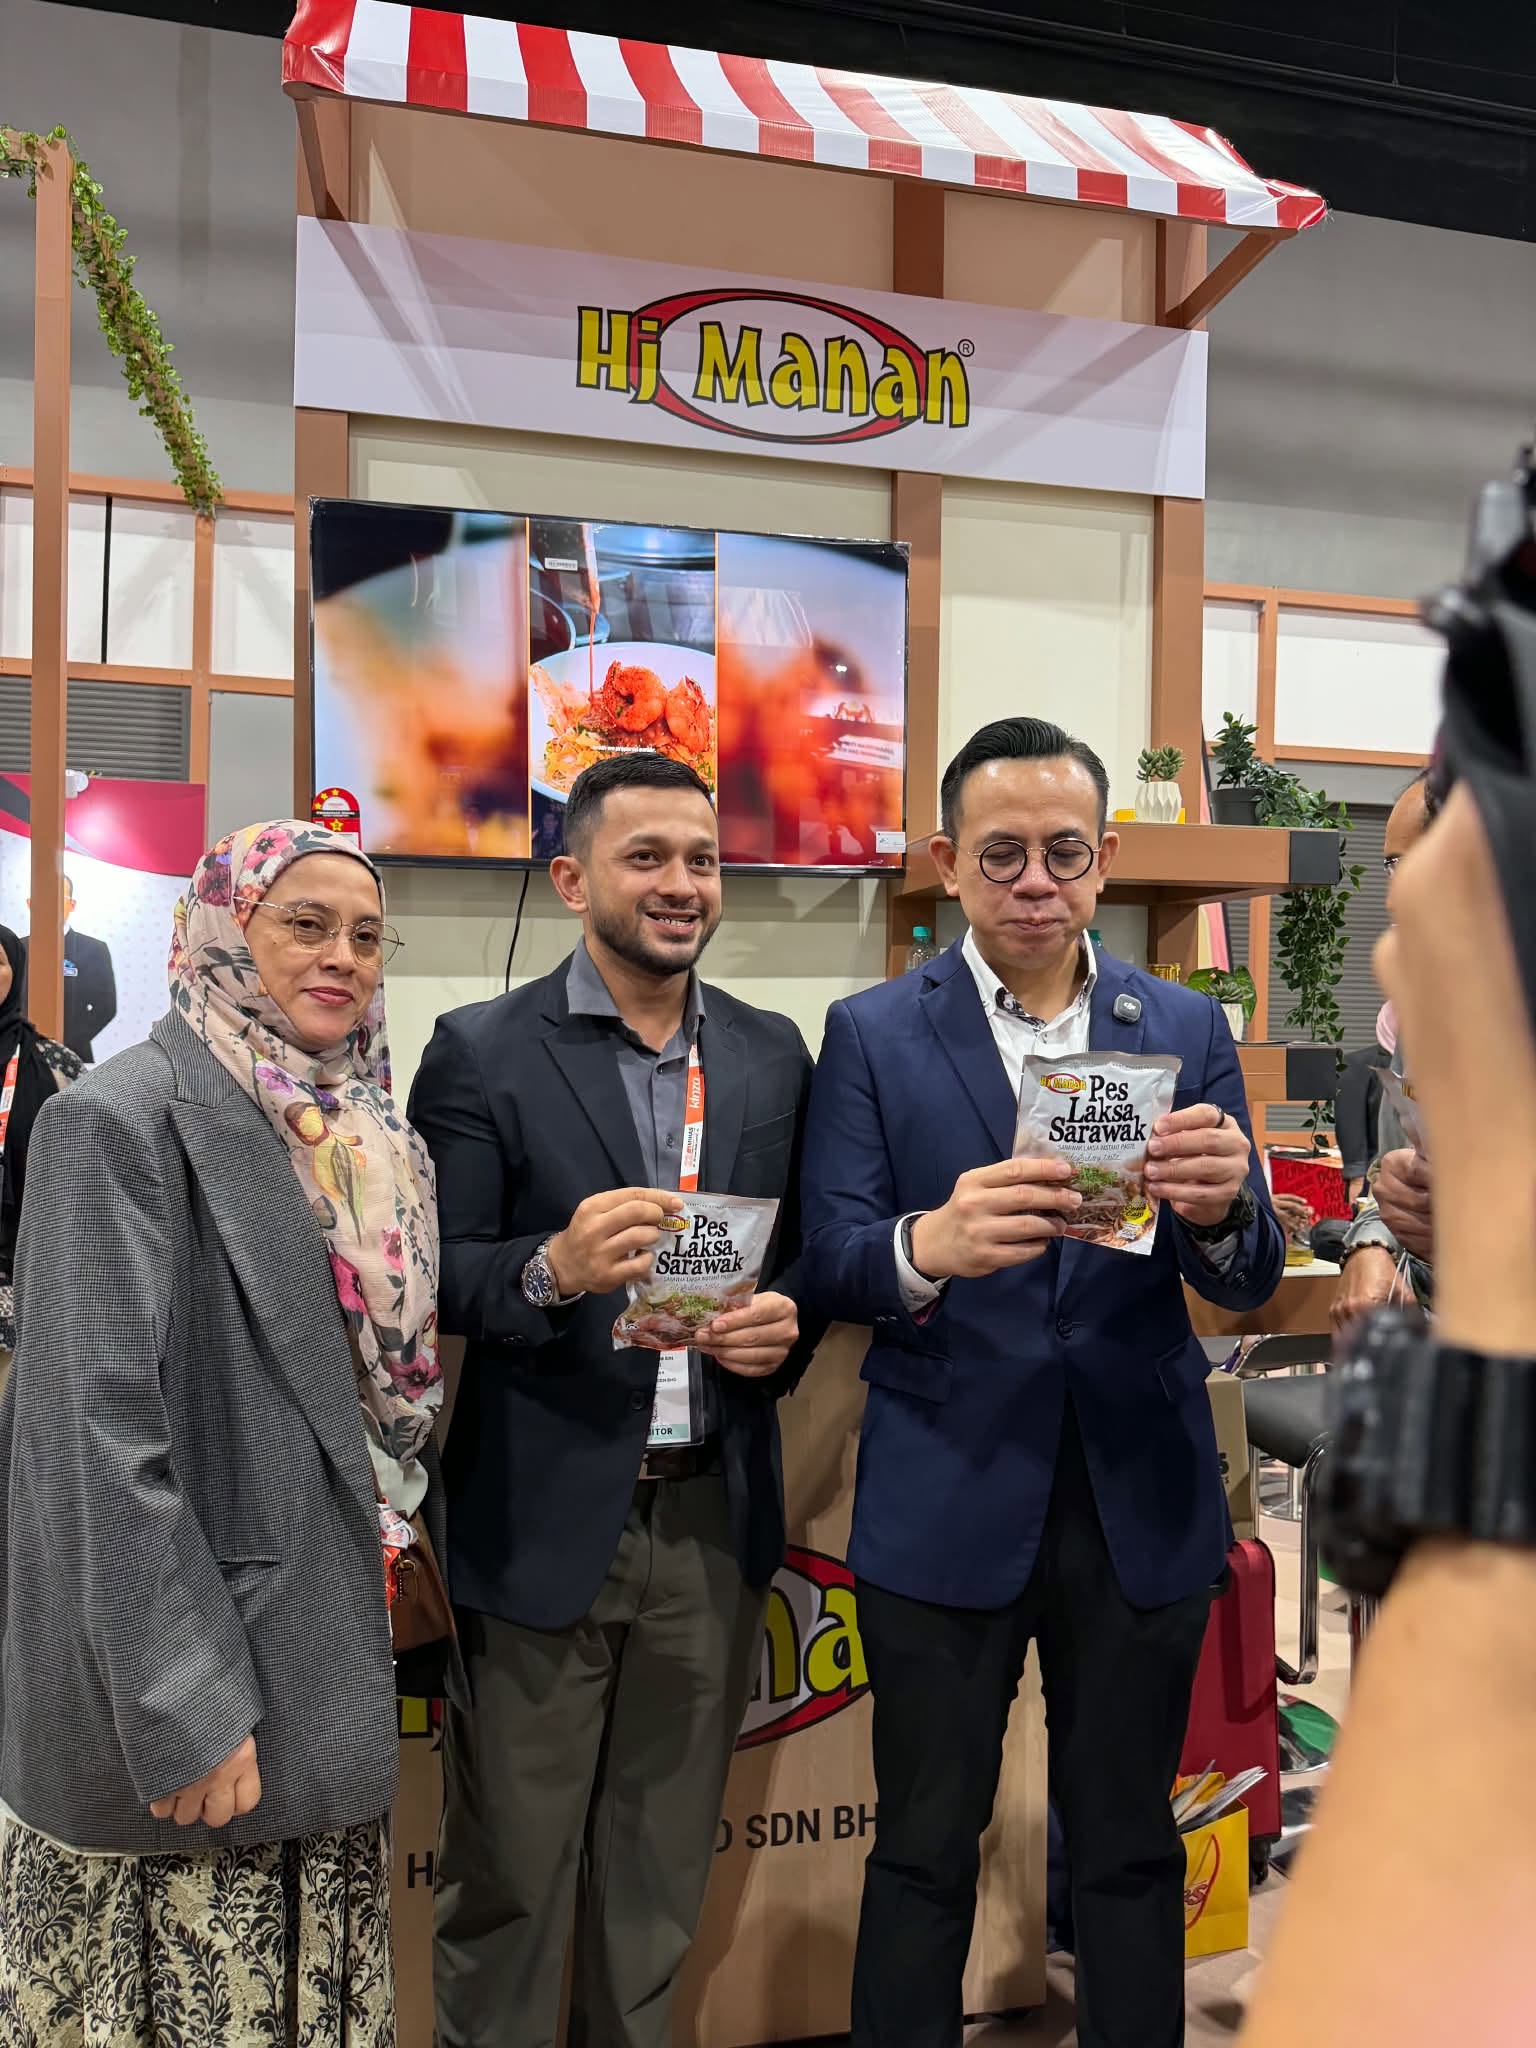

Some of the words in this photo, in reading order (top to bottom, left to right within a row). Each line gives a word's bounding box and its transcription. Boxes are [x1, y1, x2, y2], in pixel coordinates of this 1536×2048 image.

[577, 306, 662, 403] Hj
[1088, 1075, 1129, 1102] Pes
[1066, 1096, 1134, 1123] Laksa
[1048, 1115, 1147, 1143] Sarawak
[691, 1215, 728, 1239] Pes
[672, 1234, 733, 1258] Laksa
[656, 1250, 744, 1275] Sarawak
[745, 1807, 821, 1850] SDN
[833, 1803, 878, 1840] BH
